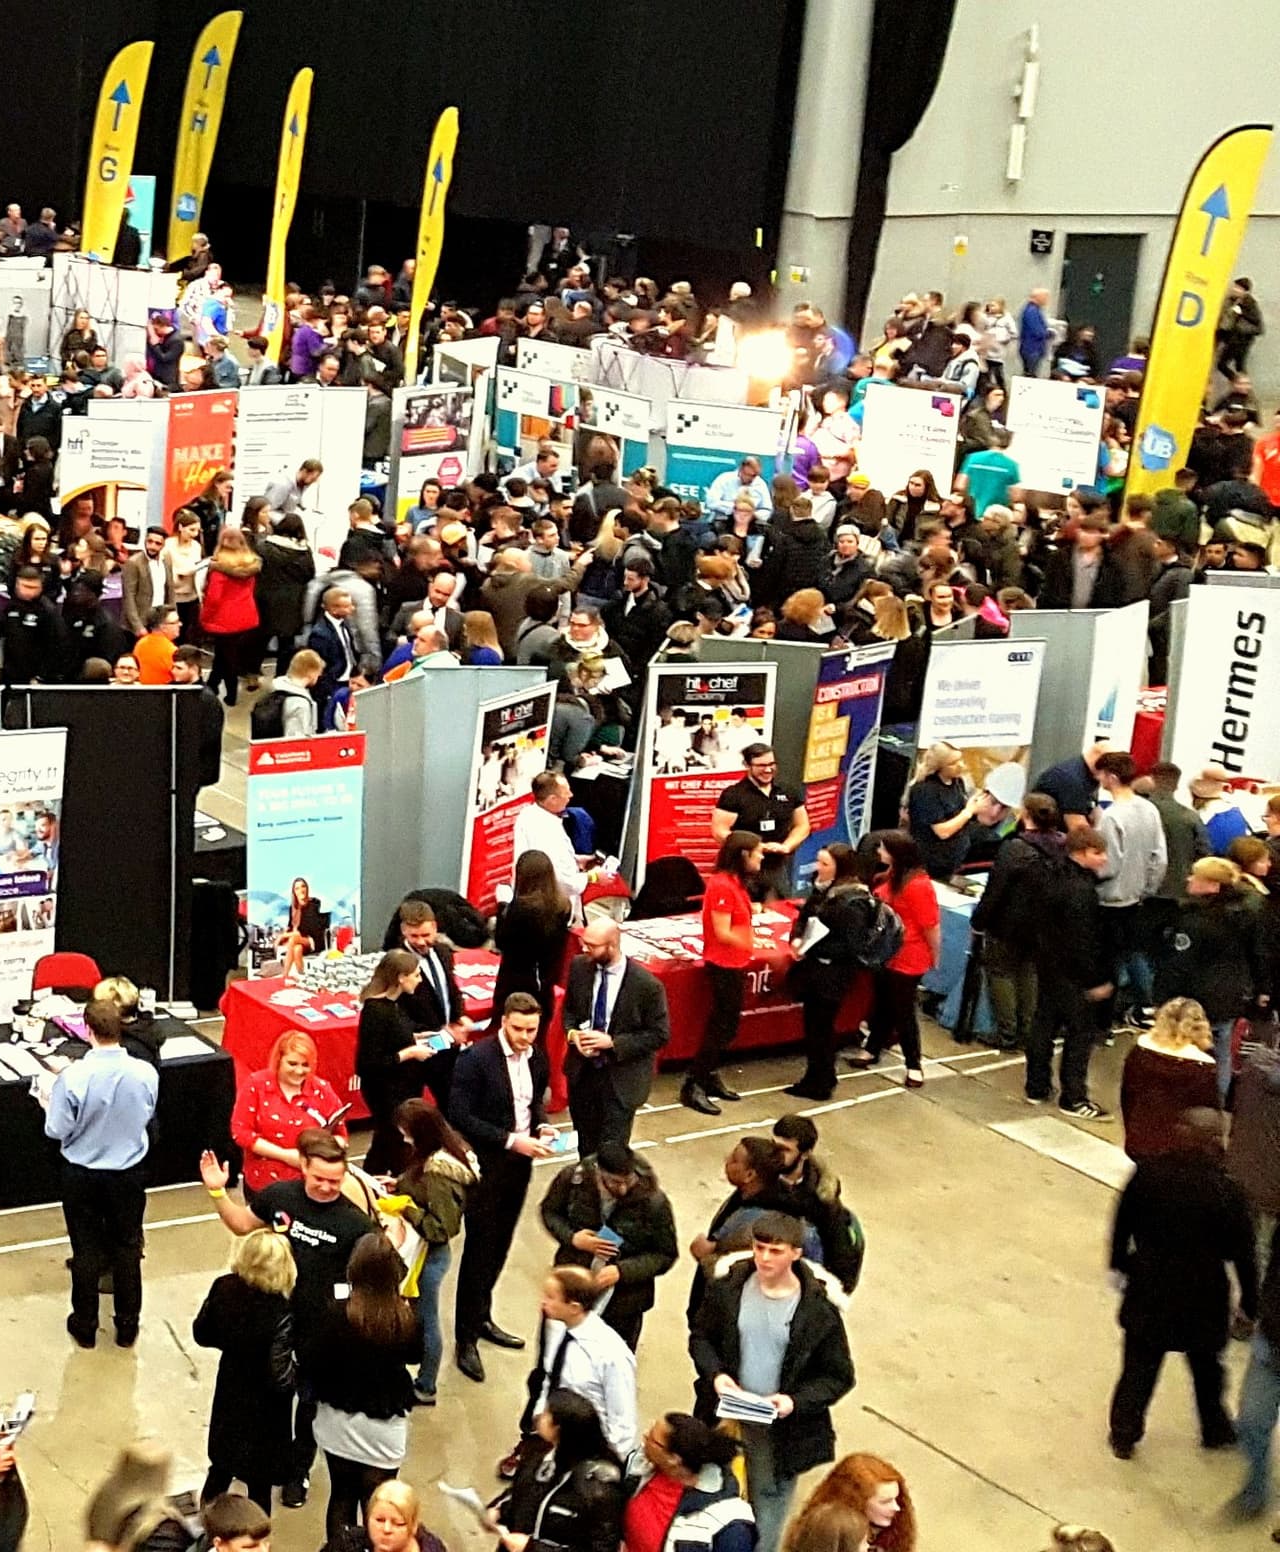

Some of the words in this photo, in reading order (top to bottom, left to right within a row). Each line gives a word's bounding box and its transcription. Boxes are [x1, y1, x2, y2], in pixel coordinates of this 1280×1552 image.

[99, 156, 118, 182] G
[1175, 290, 1205, 327] D
[173, 443, 225, 463] MAKE
[183, 460, 226, 492] Her
[708, 675, 739, 689] chef
[816, 677, 880, 703] CONSTRUCTION
[1208, 609, 1267, 774] Hermes
[289, 1227, 320, 1247] Group
